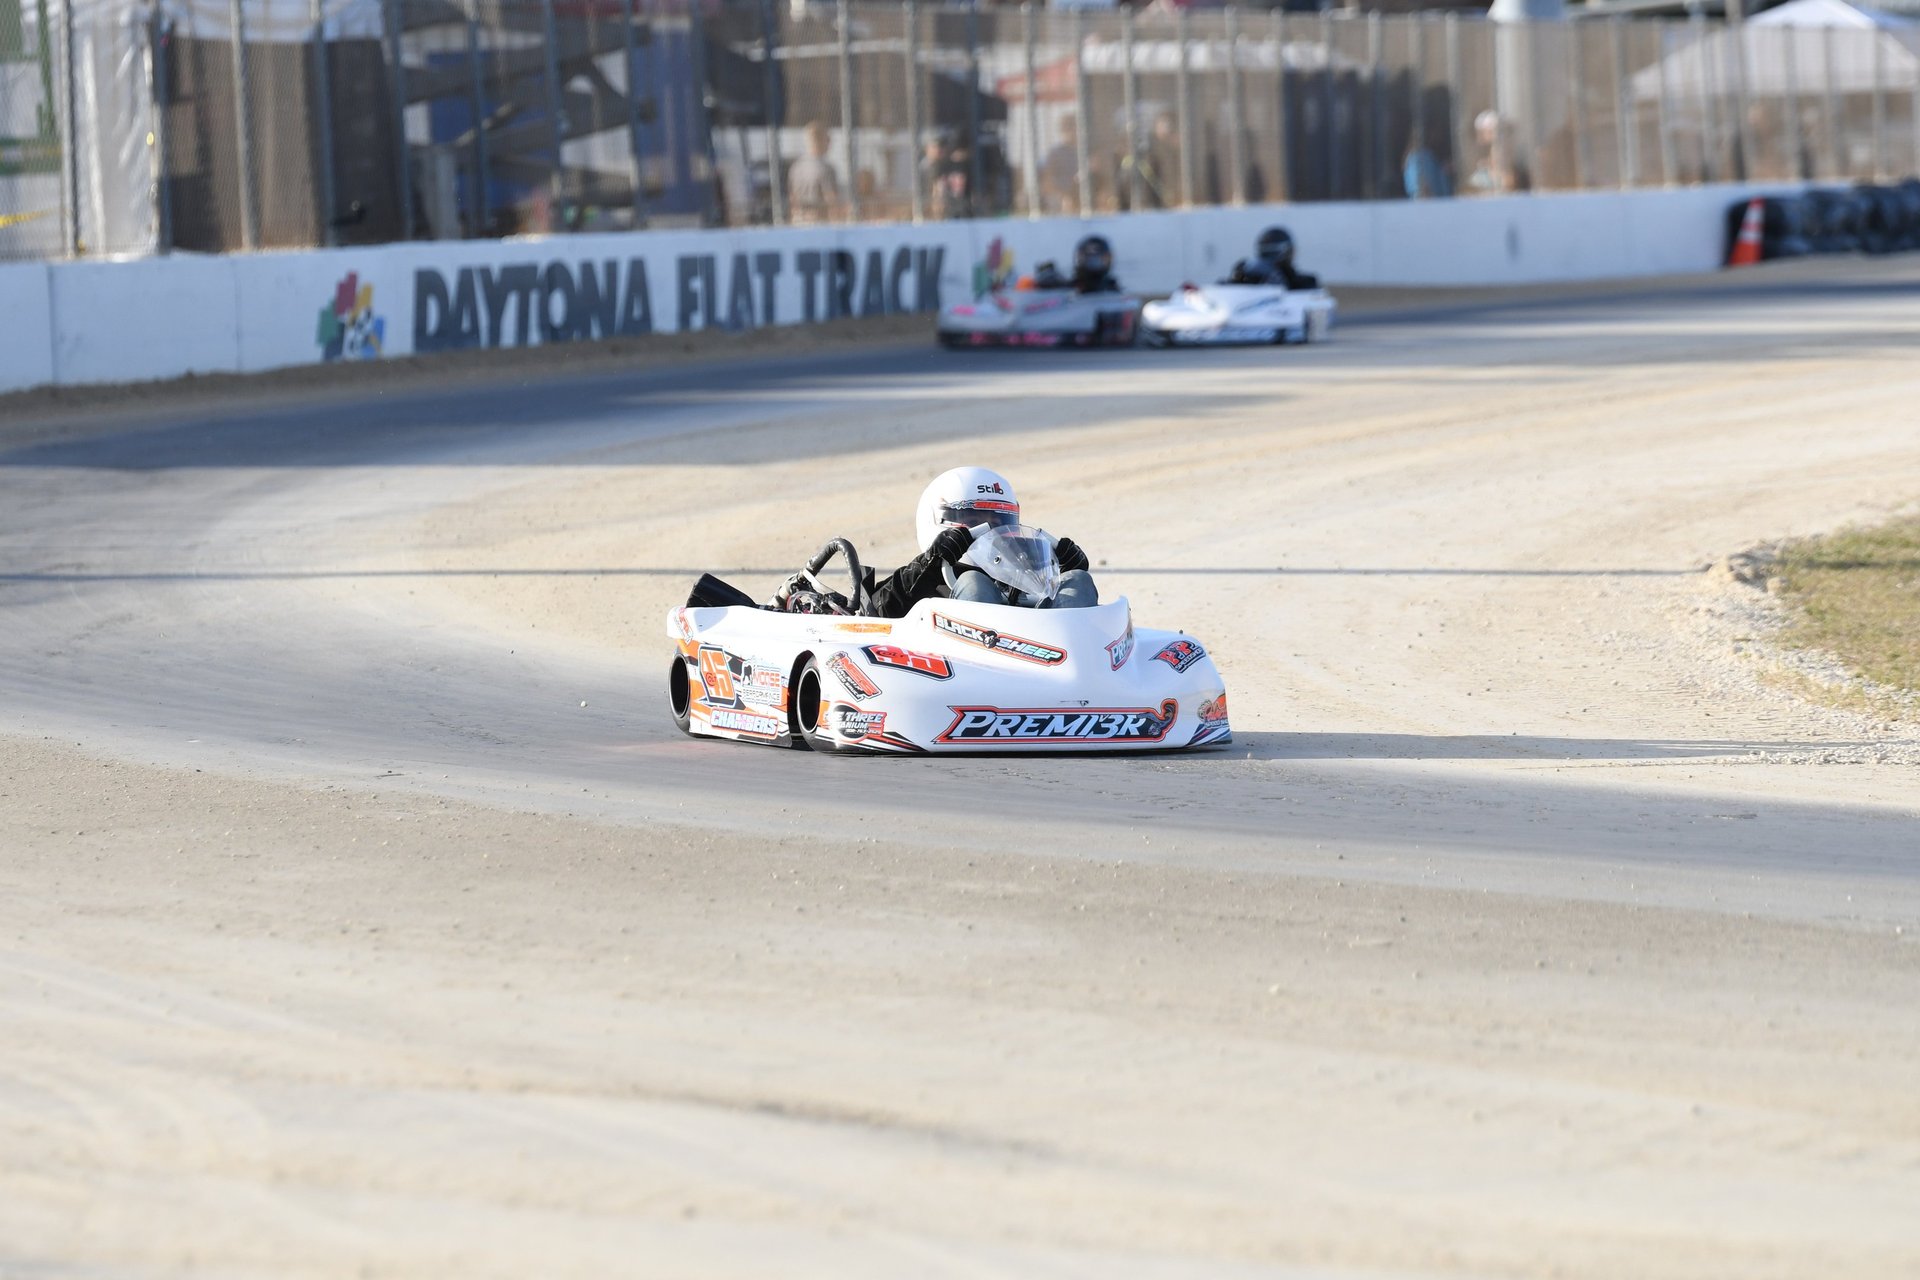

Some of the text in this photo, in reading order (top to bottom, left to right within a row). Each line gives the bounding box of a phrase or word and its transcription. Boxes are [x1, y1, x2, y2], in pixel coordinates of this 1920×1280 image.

[414, 245, 945, 353] DAYTONA FLAT TRACK
[935, 614, 983, 641] BLACK
[996, 637, 1062, 660] SHEEP
[710, 709, 778, 735] CHAMBERS
[844, 711, 884, 722] THREE
